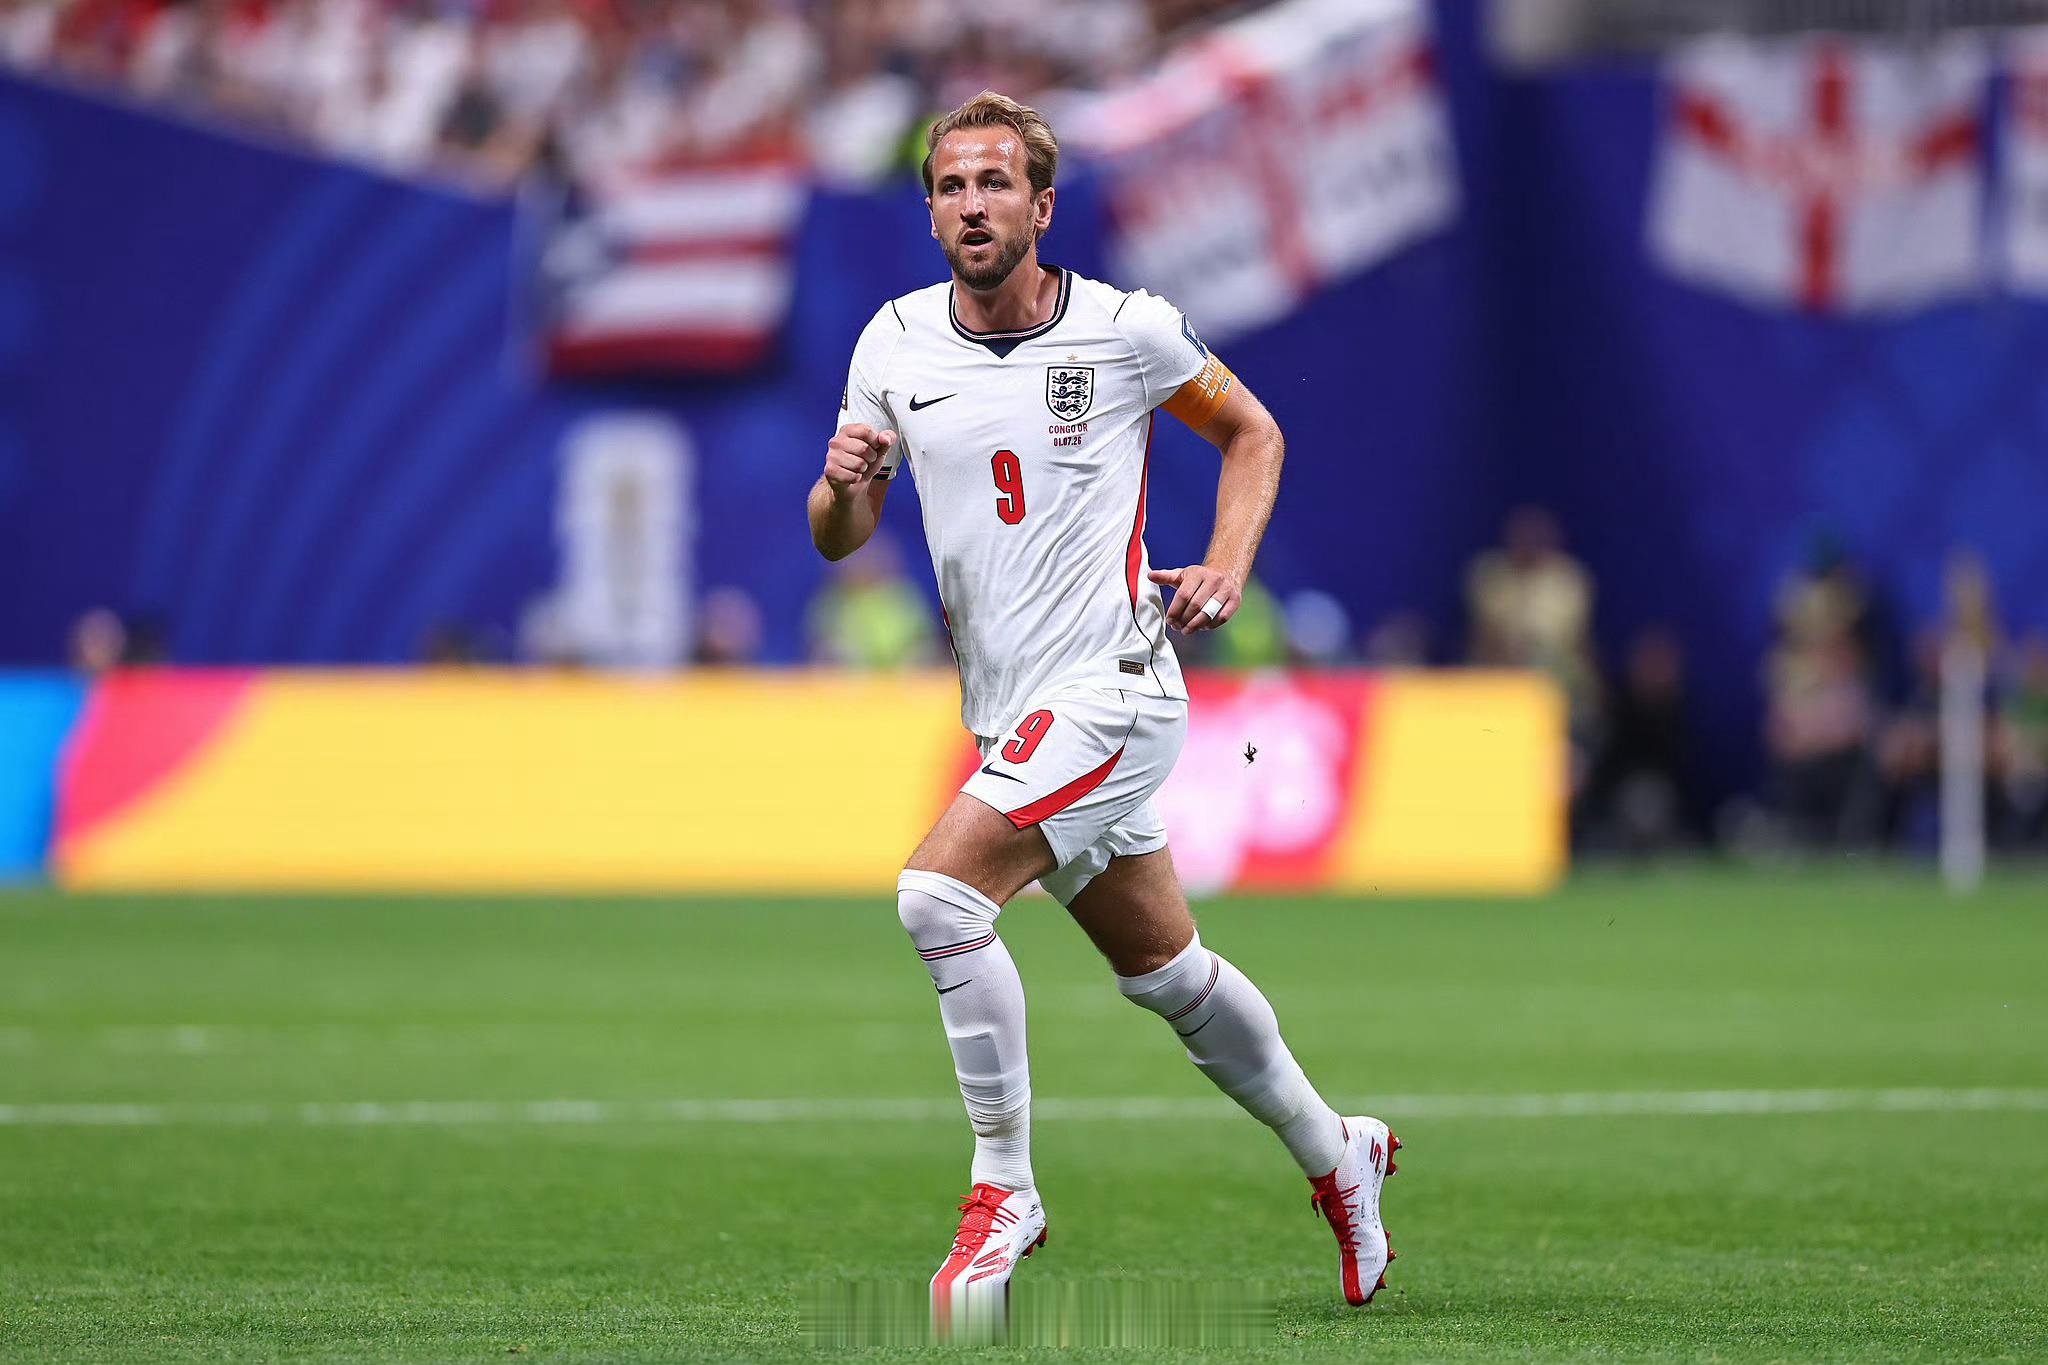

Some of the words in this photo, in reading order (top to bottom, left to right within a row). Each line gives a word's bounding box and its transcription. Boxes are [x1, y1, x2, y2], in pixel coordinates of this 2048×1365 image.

[1048, 424, 1076, 434] CONGO
[1053, 436, 1082, 447] 01.07.26
[991, 449, 1026, 525] 9
[1001, 709, 1054, 764] 9
